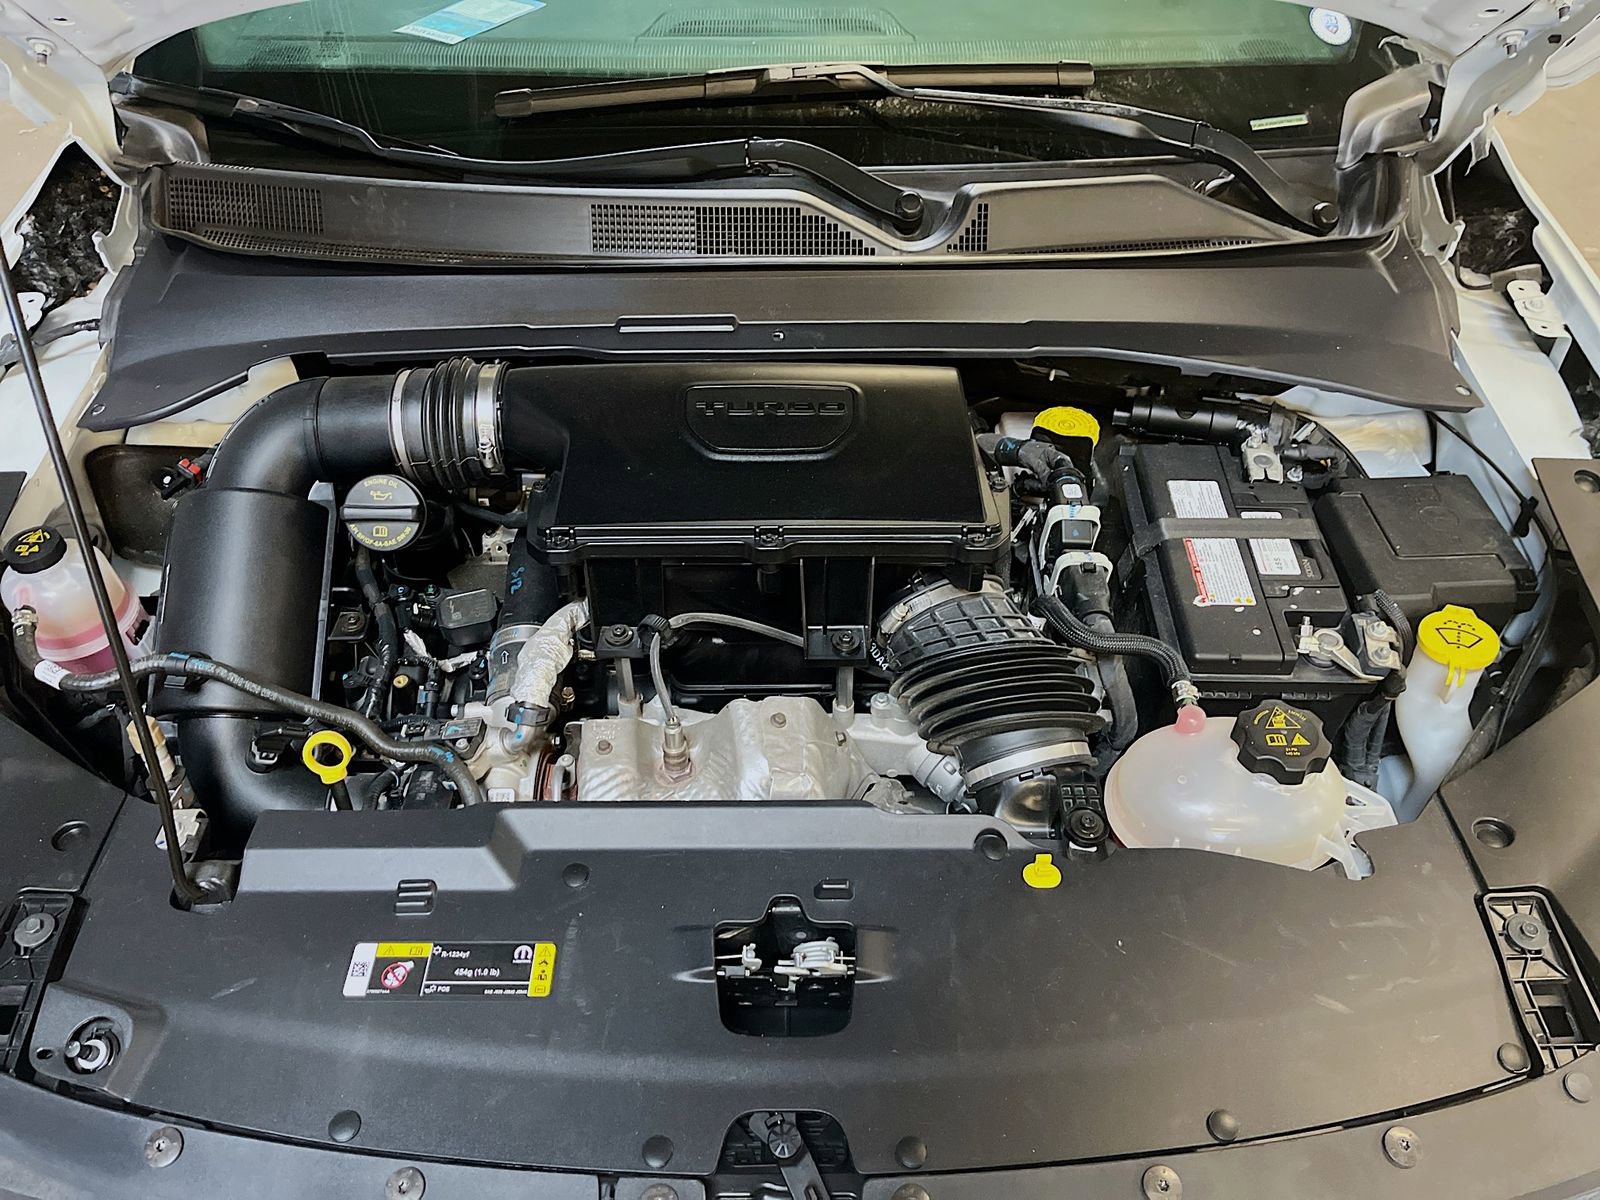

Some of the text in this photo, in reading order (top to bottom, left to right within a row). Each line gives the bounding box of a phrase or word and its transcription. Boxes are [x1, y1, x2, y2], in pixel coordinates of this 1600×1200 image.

[696, 402, 846, 416] TURBO
[364, 478, 398, 488] ENGINE OIL
[441, 951, 471, 959] R-1234yf
[454, 968, 500, 977] 454g (1.0 lb)
